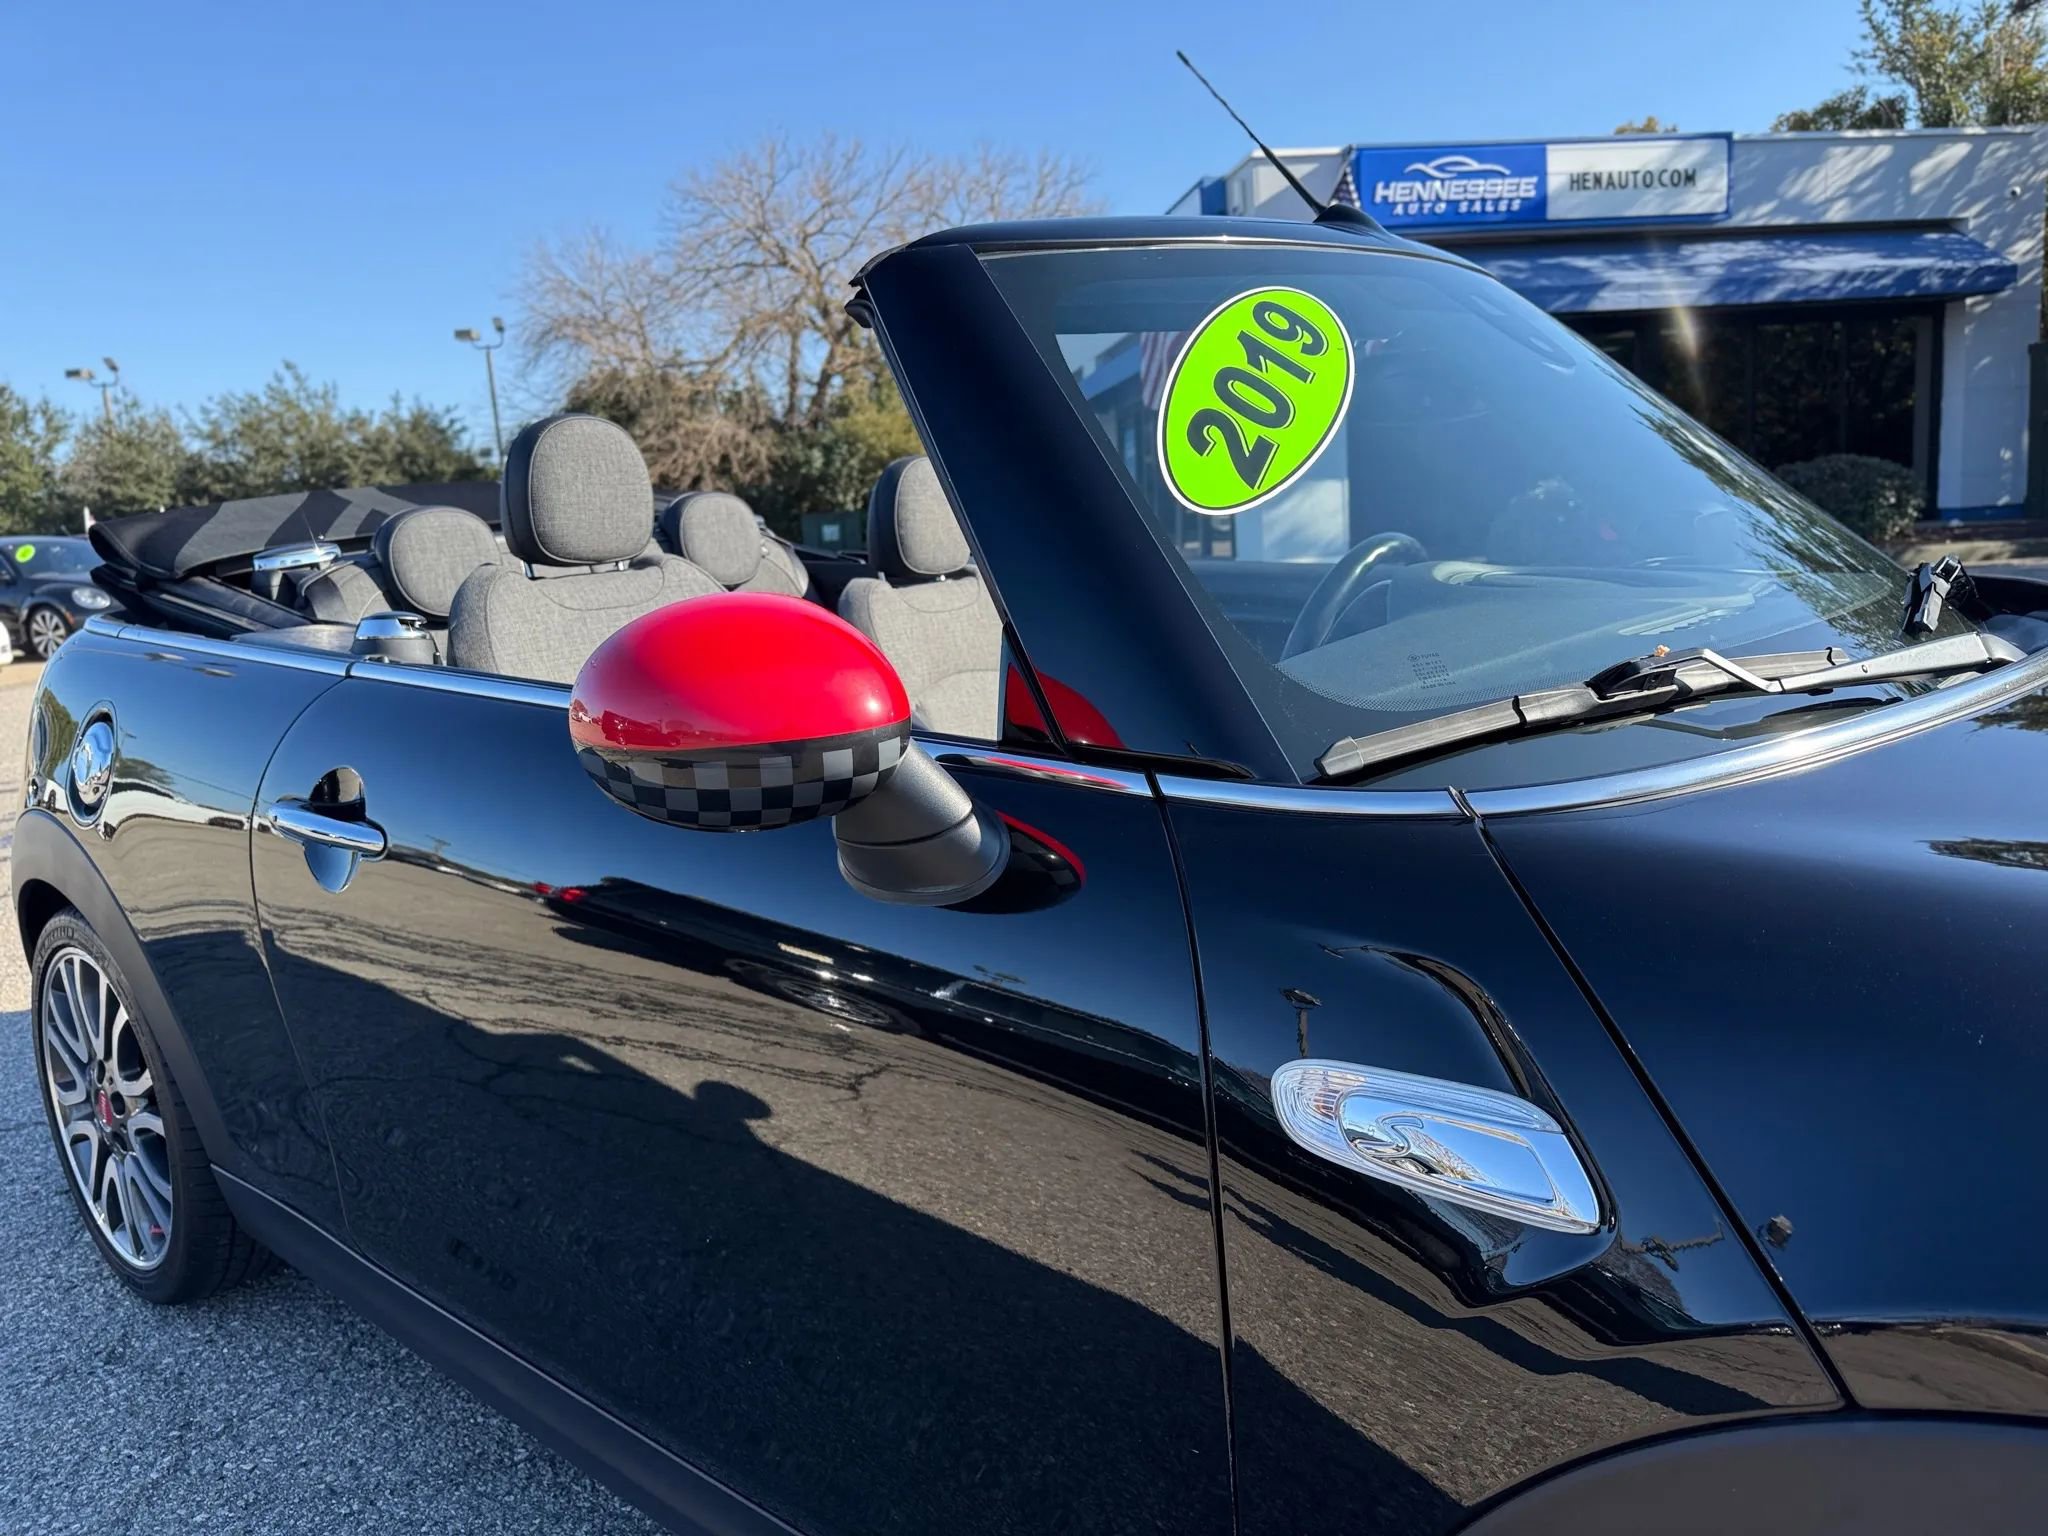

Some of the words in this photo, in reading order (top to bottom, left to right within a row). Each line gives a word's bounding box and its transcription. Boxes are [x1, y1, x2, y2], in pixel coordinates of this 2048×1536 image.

[1373, 176, 1538, 204] HENNESSEE
[1392, 202, 1447, 216] AUTO
[1458, 199, 1522, 214] SALES
[1186, 300, 1329, 490] 2019
